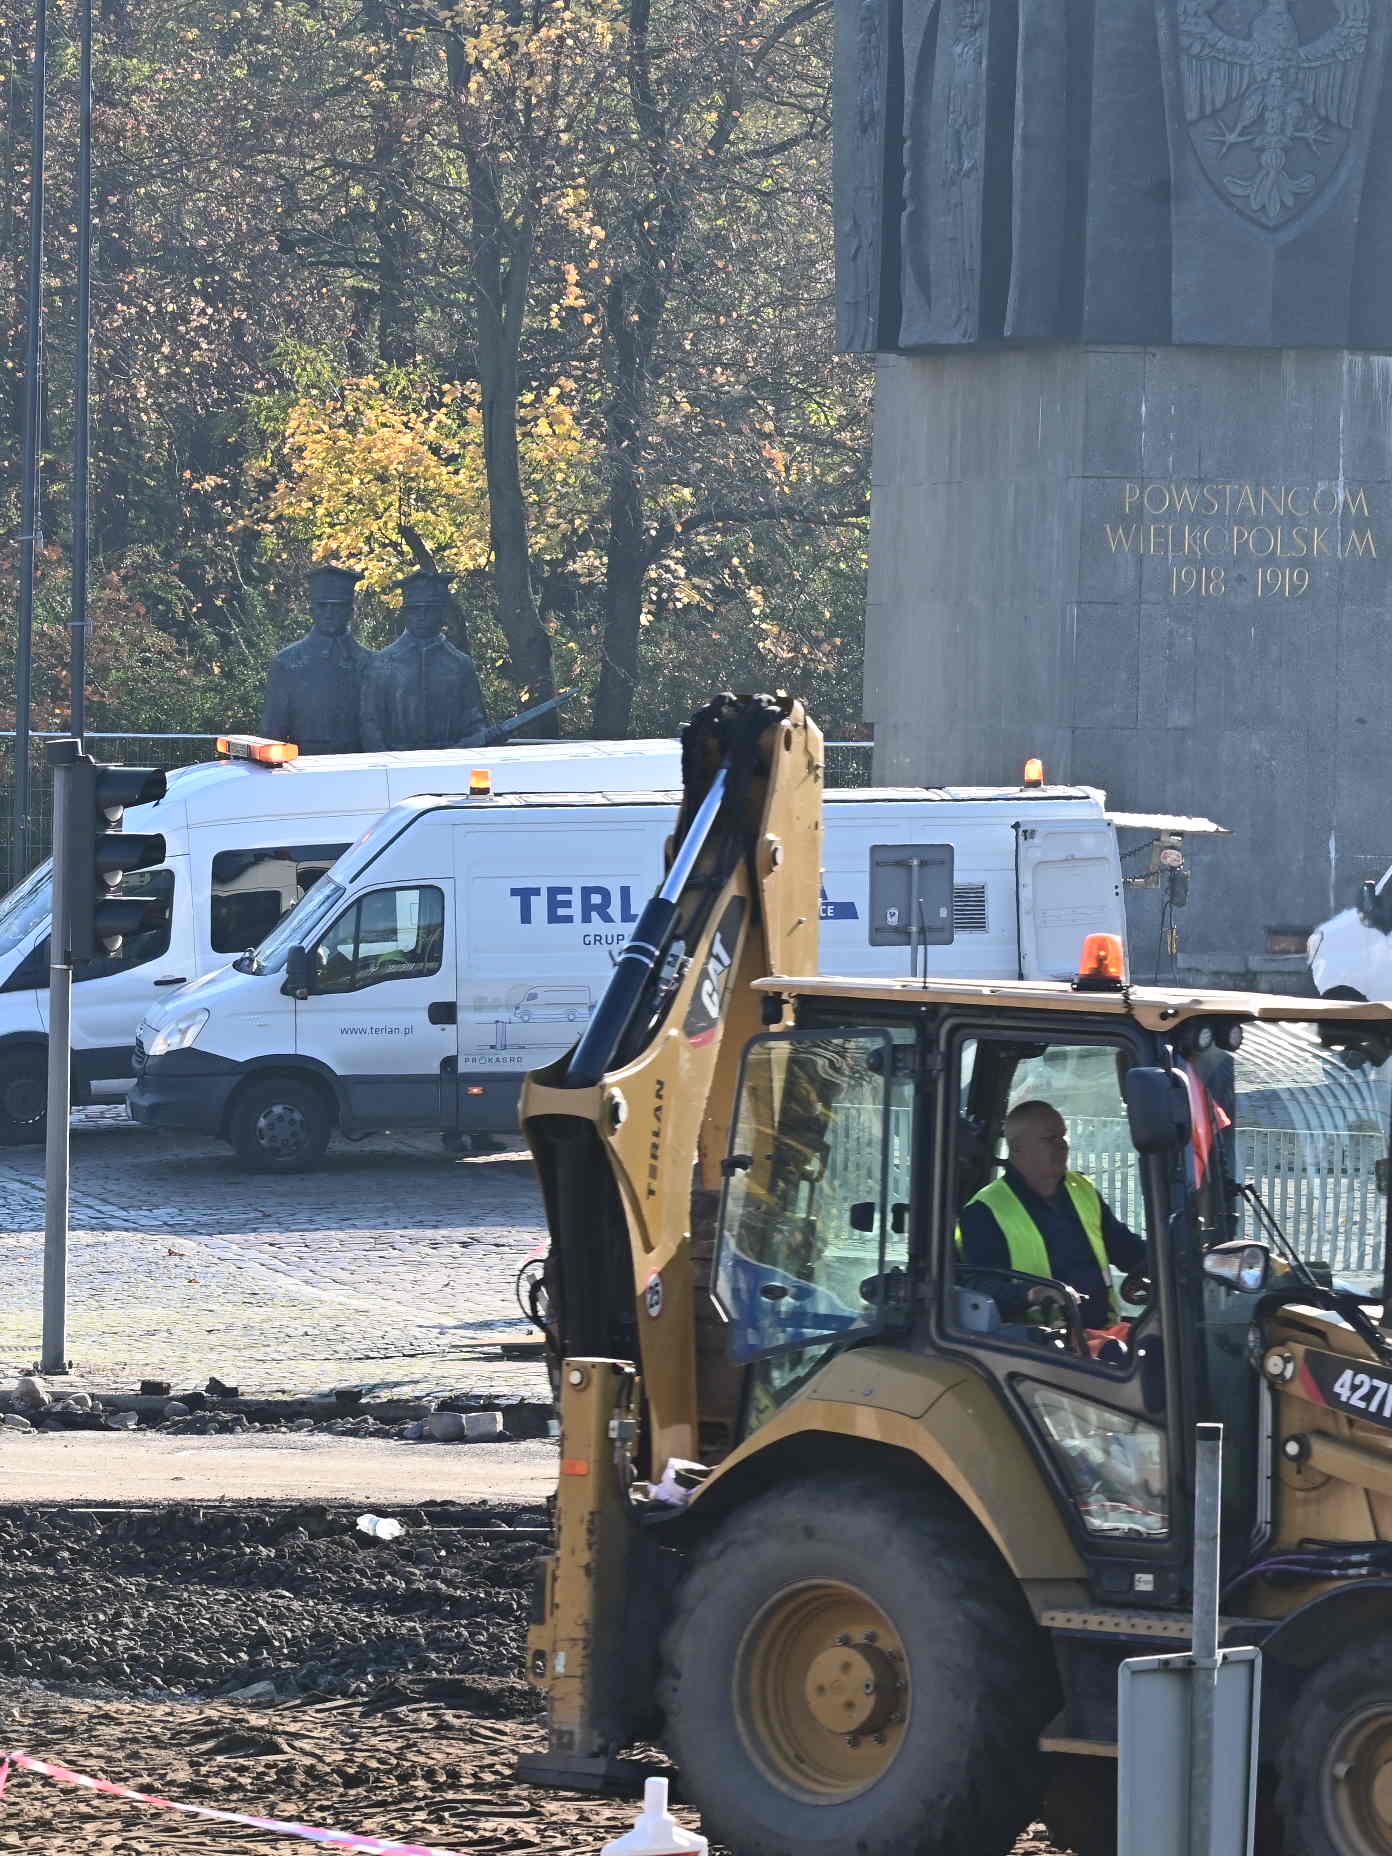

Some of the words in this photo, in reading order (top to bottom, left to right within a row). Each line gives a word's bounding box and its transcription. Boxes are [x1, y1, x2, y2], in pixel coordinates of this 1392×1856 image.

[1171, 566, 1226, 597] 1918
[1256, 567, 1311, 598] 1919
[509, 885, 640, 925] TERL
[582, 934, 626, 946] GRUP
[701, 930, 731, 1019] CAT
[339, 1024, 414, 1037] www.terlan.pl
